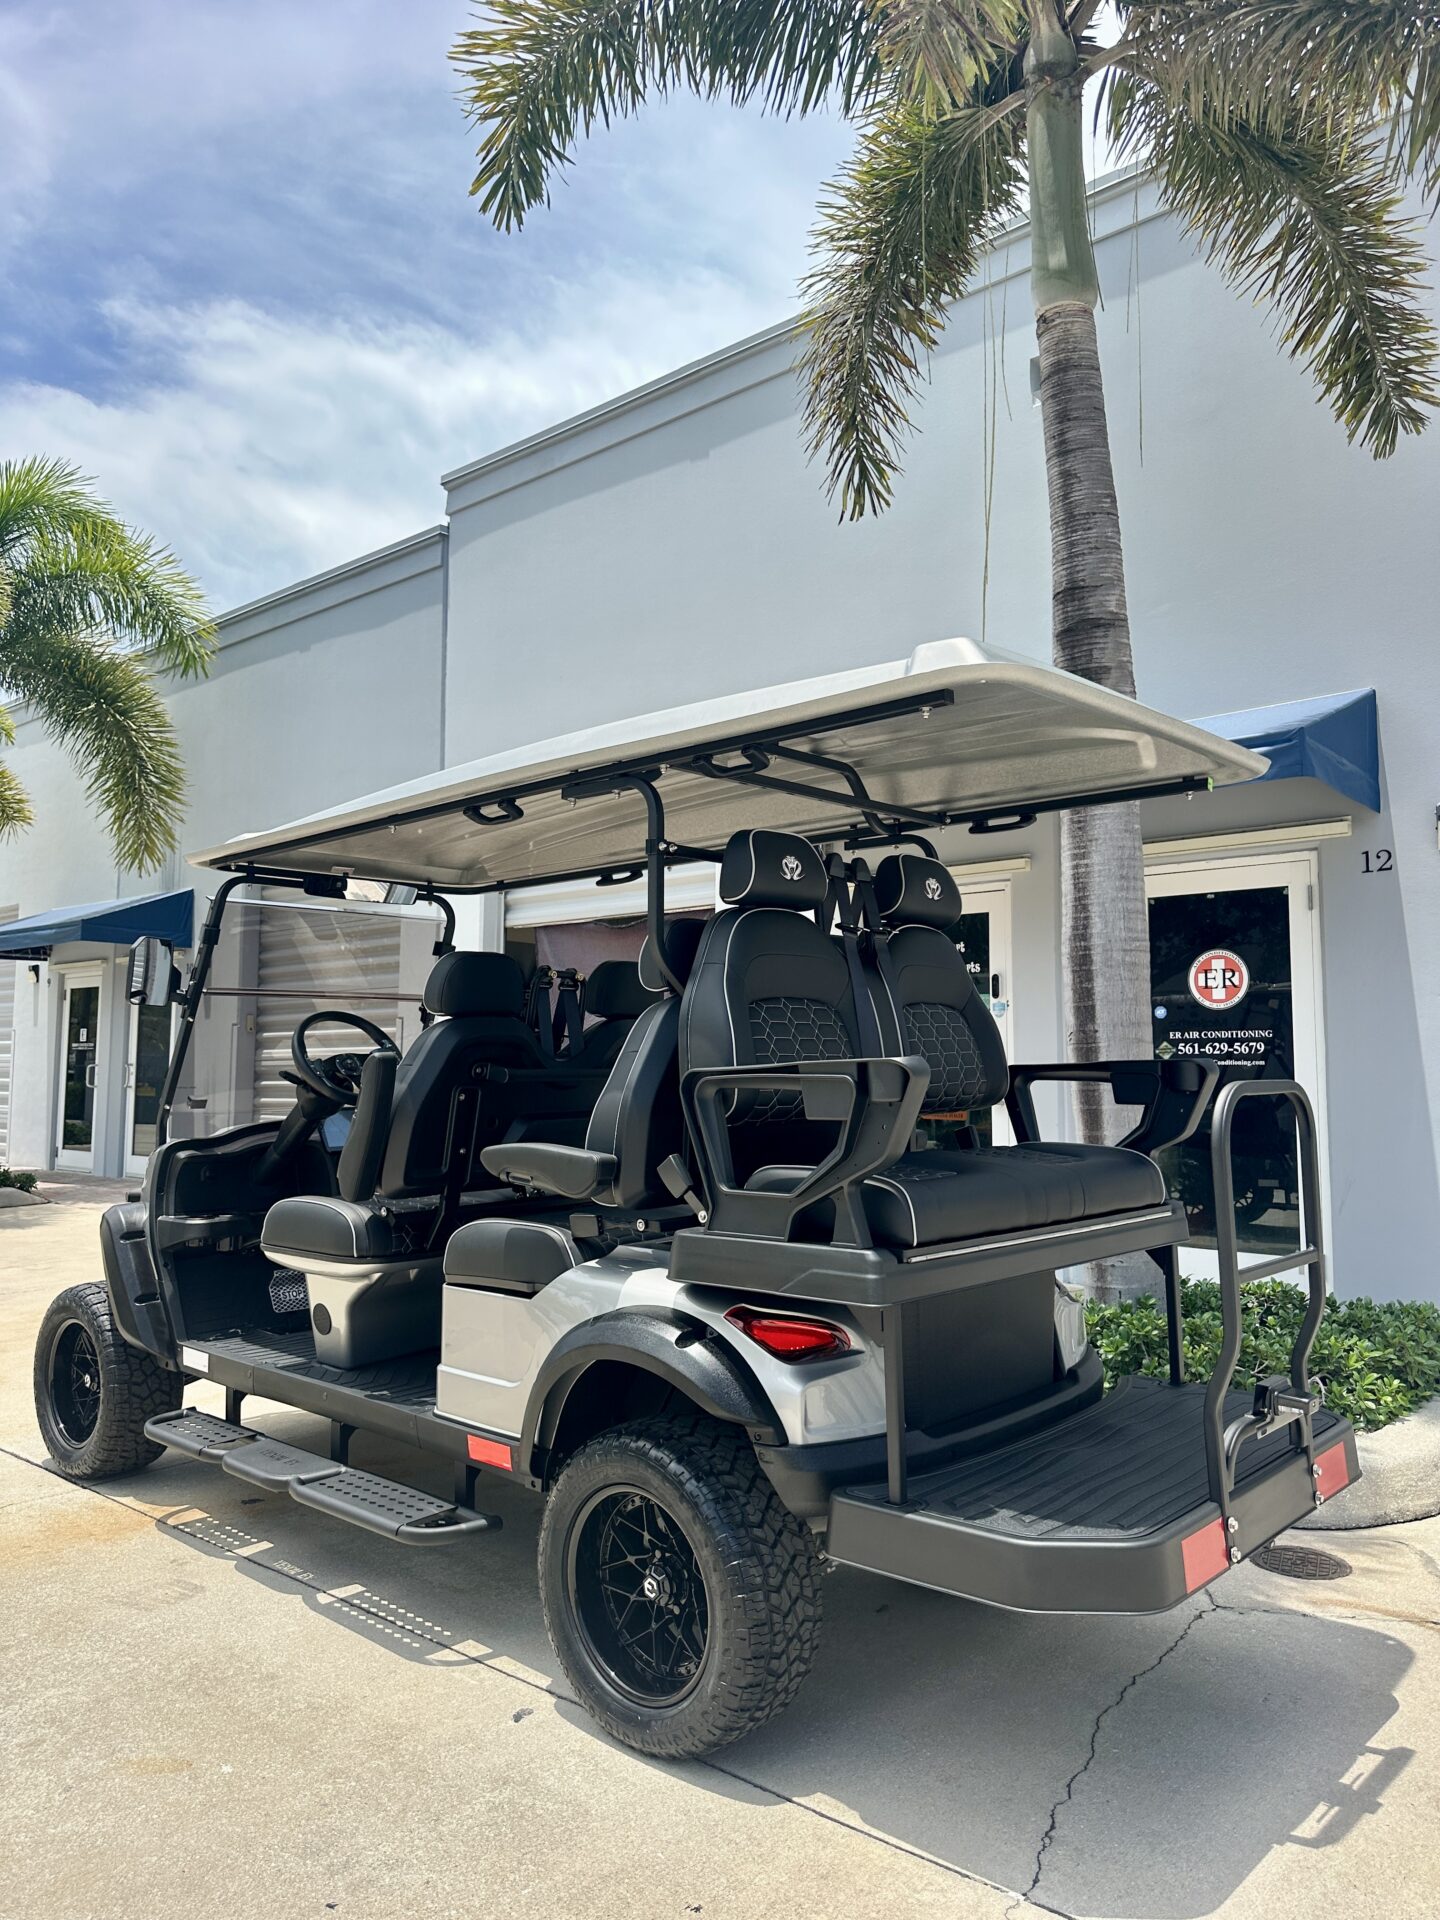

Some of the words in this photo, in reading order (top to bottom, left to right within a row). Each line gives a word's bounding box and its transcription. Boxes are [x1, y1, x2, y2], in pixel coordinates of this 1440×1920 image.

[1361, 849, 1392, 873] 12
[1202, 968, 1240, 989] ER
[1169, 1031, 1181, 1039] ER
[1183, 1031, 1199, 1039] AIR
[1201, 1029, 1273, 1039] CONDITIONING
[1177, 1042, 1265, 1055] 561-629-5679
[282, 1290, 302, 1299] STOP
